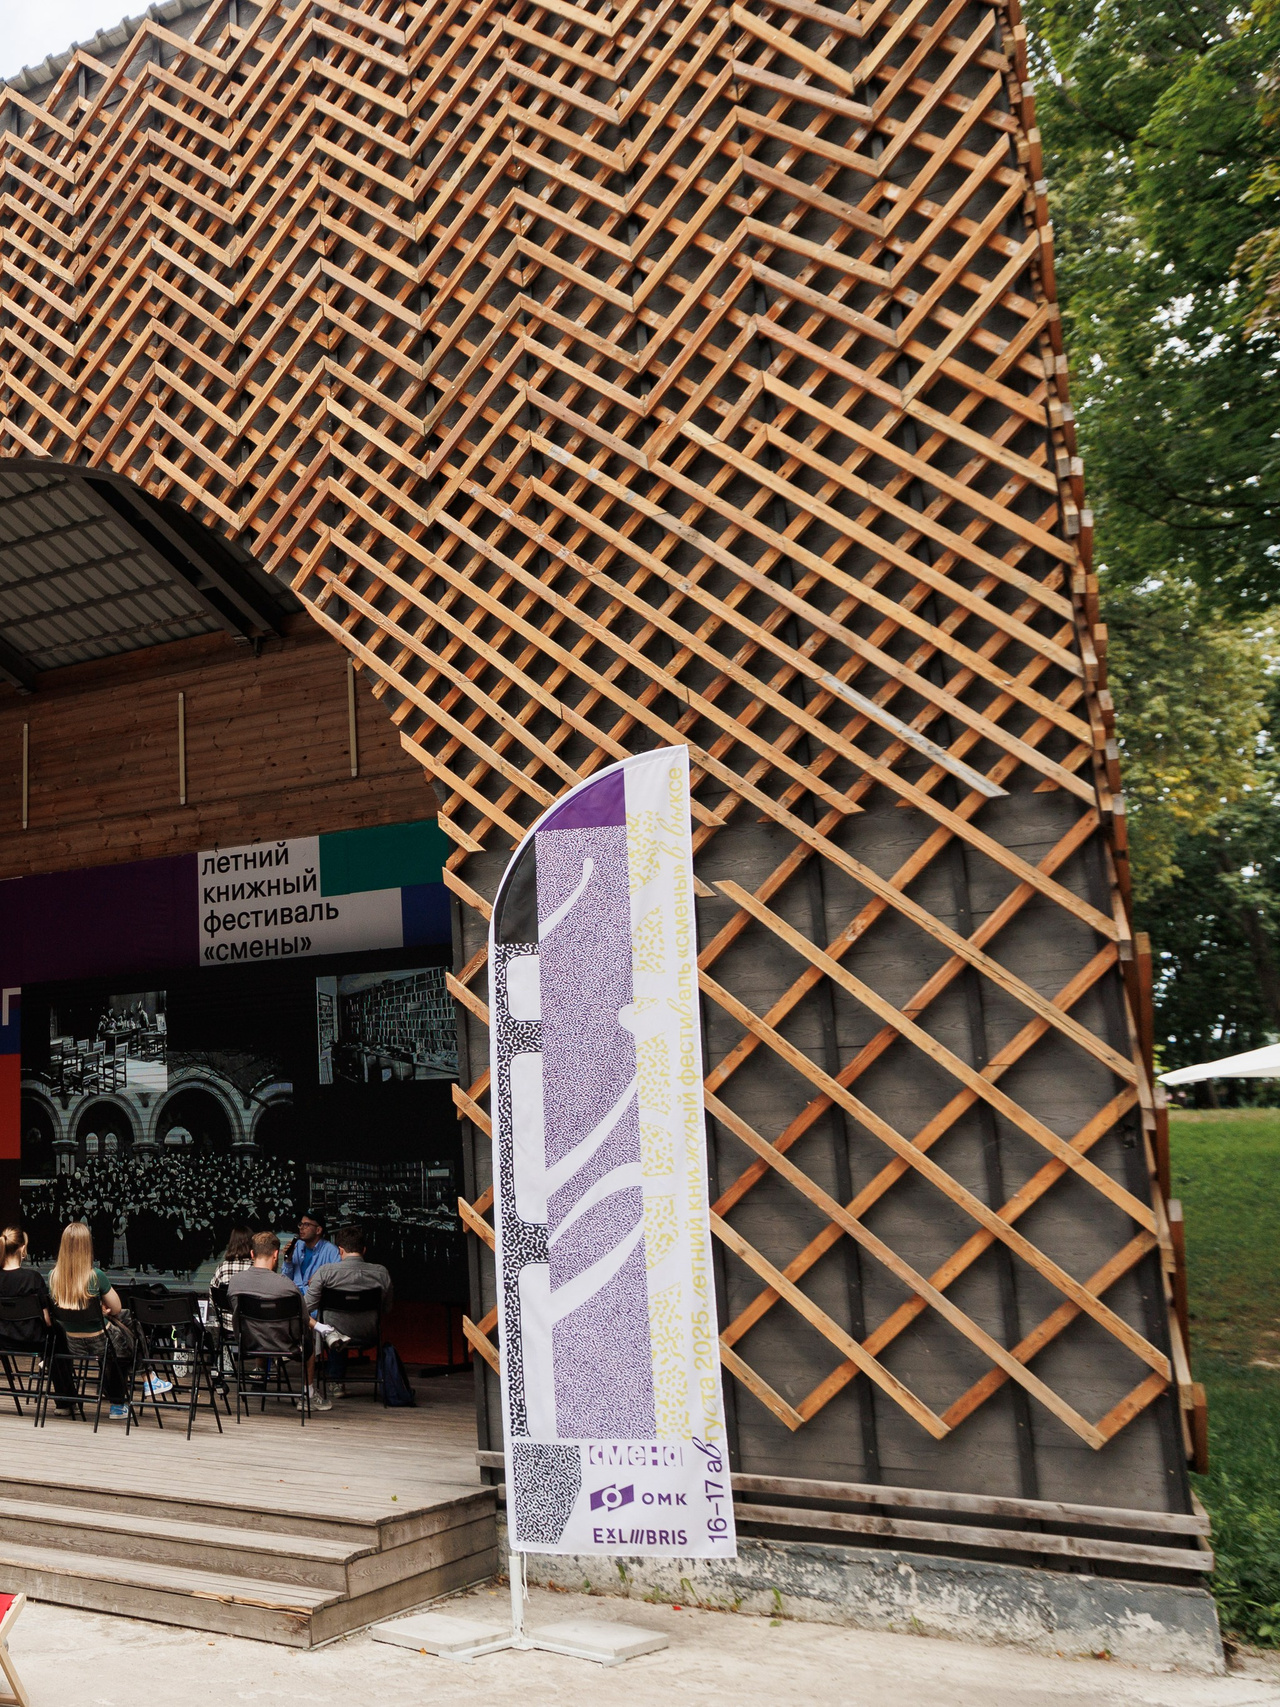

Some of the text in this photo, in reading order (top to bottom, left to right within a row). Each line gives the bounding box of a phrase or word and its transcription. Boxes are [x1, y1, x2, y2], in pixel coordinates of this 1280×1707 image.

[656, 767, 685, 837] выксе
[202, 842, 289, 875] летний
[204, 868, 317, 904] книжный
[204, 903, 339, 938] фестиваль
[673, 864, 690, 959] «смены»
[204, 936, 312, 961] «смены»
[667, 963, 701, 1086] фестиваль
[677, 1092, 703, 1210] книжный
[684, 1217, 710, 1308] летний
[692, 1310, 713, 1371] 2025
[692, 1377, 724, 1473] августа
